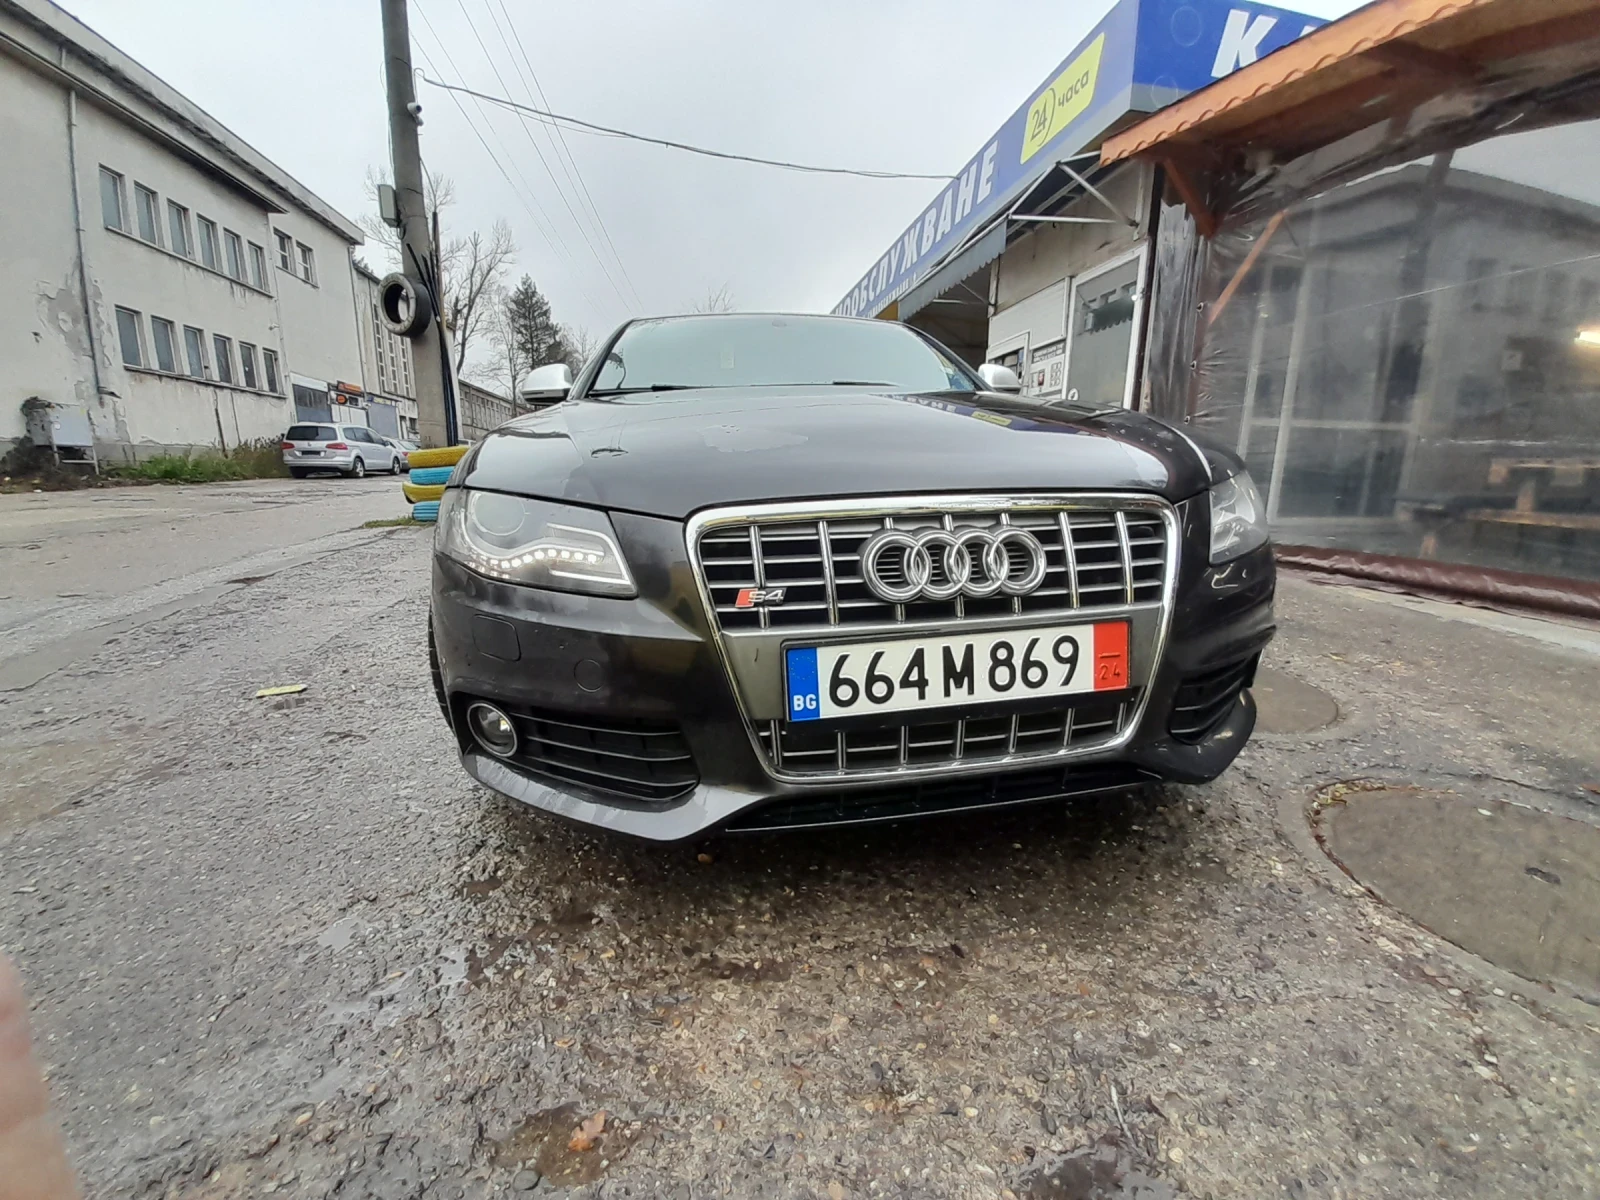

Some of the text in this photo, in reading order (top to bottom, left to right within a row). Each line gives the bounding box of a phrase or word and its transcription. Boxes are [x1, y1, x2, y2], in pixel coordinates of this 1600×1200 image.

[1058, 70, 1090, 107] часа
[747, 589, 784, 604] S4
[829, 647, 929, 708] 664
[988, 635, 1080, 693] 869
[1099, 662, 1121, 681] 24
[792, 693, 817, 711] BG
